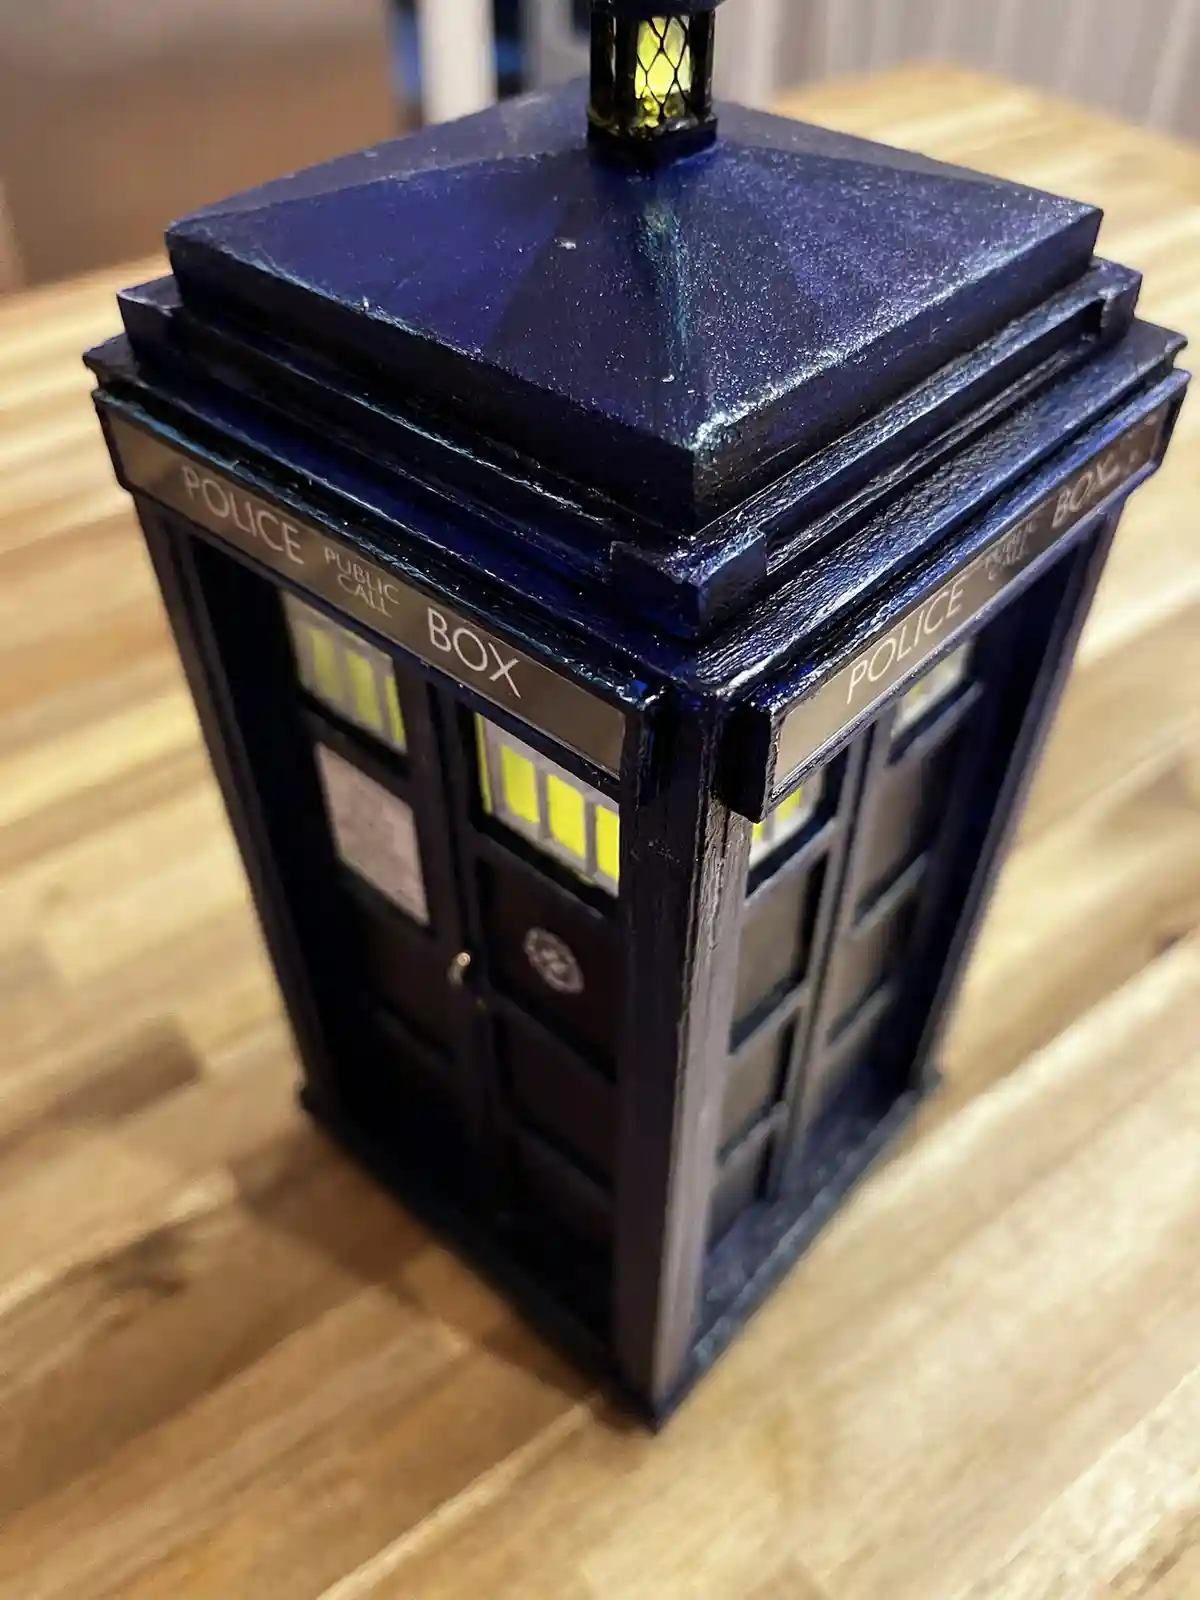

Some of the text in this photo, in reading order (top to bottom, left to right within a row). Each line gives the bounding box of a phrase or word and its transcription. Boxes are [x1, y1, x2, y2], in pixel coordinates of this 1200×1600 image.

[183, 467, 521, 698] POLICE BOX
[324, 547, 400, 605] PUBLIC
[337, 573, 392, 618] CALL
[847, 576, 964, 704] POLICE
